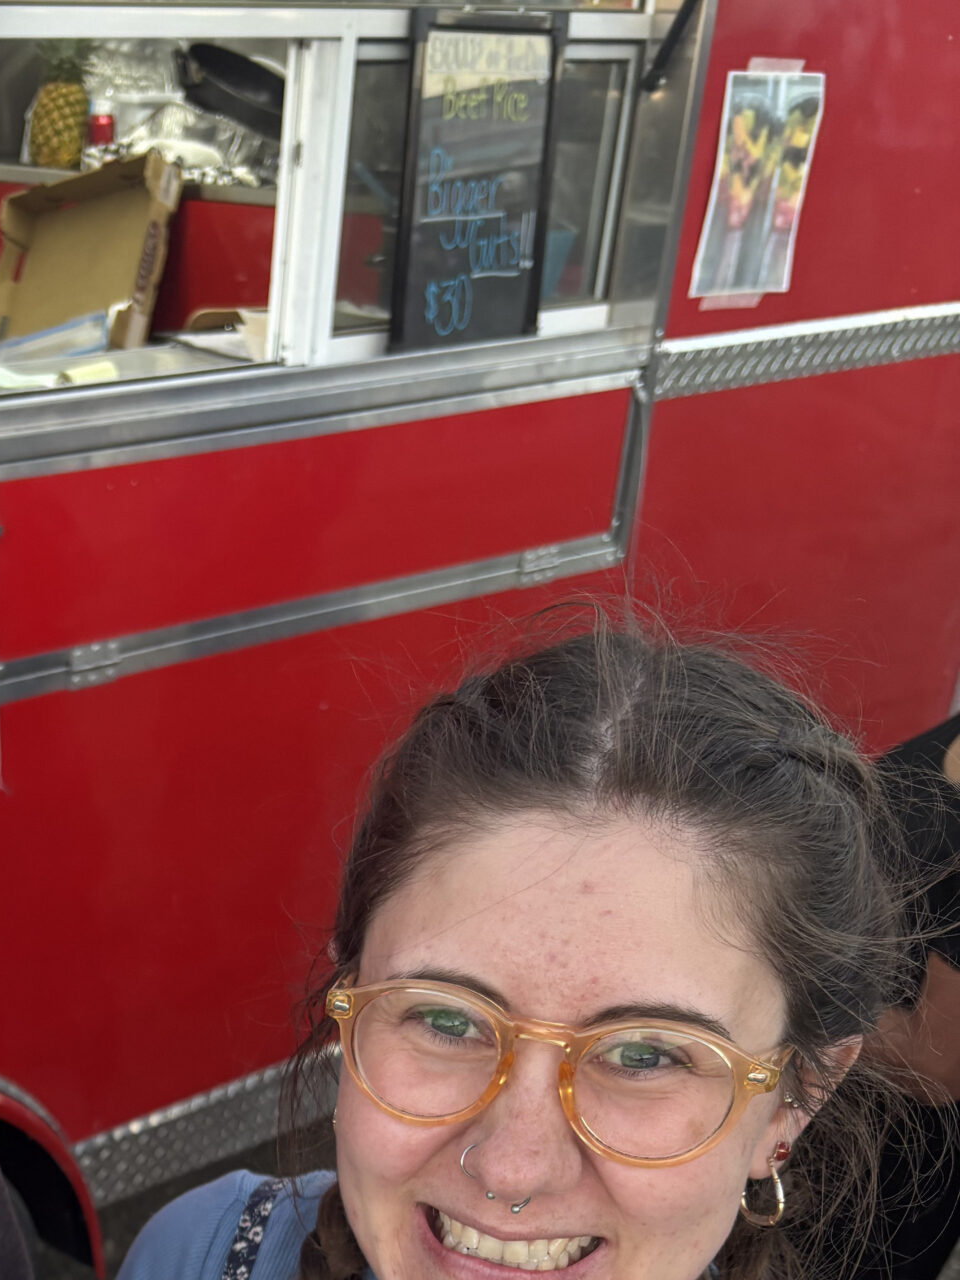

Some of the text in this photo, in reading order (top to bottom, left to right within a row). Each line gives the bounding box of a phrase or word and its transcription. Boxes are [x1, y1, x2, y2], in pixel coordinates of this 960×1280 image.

[442, 76, 488, 120] Beef
[427, 148, 505, 249] Bigger
[424, 273, 473, 336] $30
